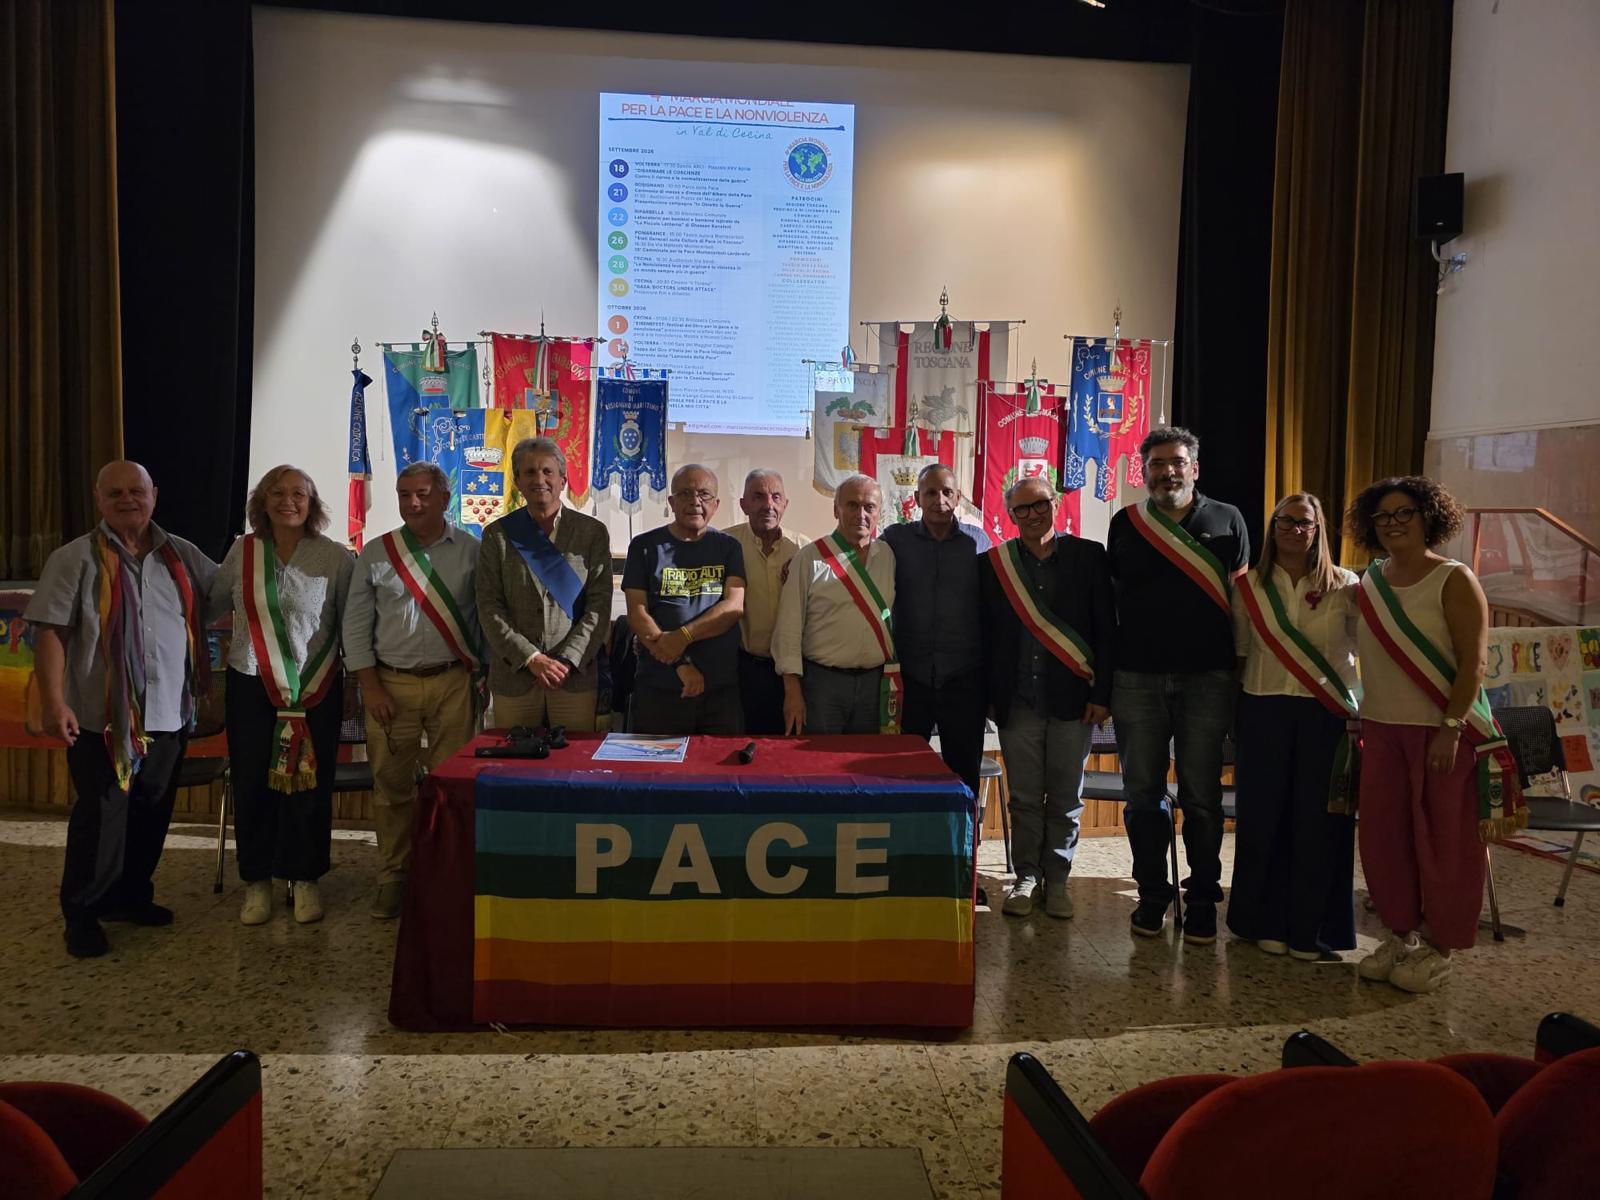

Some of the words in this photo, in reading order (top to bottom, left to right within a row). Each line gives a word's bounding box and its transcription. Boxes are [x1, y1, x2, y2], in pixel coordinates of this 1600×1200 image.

[622, 104, 646, 115] PER
[650, 105, 666, 116] LA
[669, 106, 702, 118] PACE
[706, 108, 712, 118] E
[716, 108, 732, 120] LA
[735, 109, 829, 123] NONVIOLENZA
[675, 128, 687, 136] in
[692, 126, 712, 136] Val
[716, 127, 728, 138] di
[732, 128, 773, 140] Cecina
[614, 164, 624, 172] 18
[612, 188, 623, 196] 21
[612, 212, 624, 221] 22
[612, 236, 624, 245] 26
[612, 260, 624, 268] 28
[610, 284, 624, 292] 30
[914, 342, 971, 354] RENE
[914, 357, 972, 369] TOSCANA
[1084, 366, 1107, 380] COMUNE
[998, 410, 1024, 428] COMUNE
[668, 570, 698, 582] RADIO
[700, 566, 724, 578] AUT
[576, 822, 891, 895] PACE
